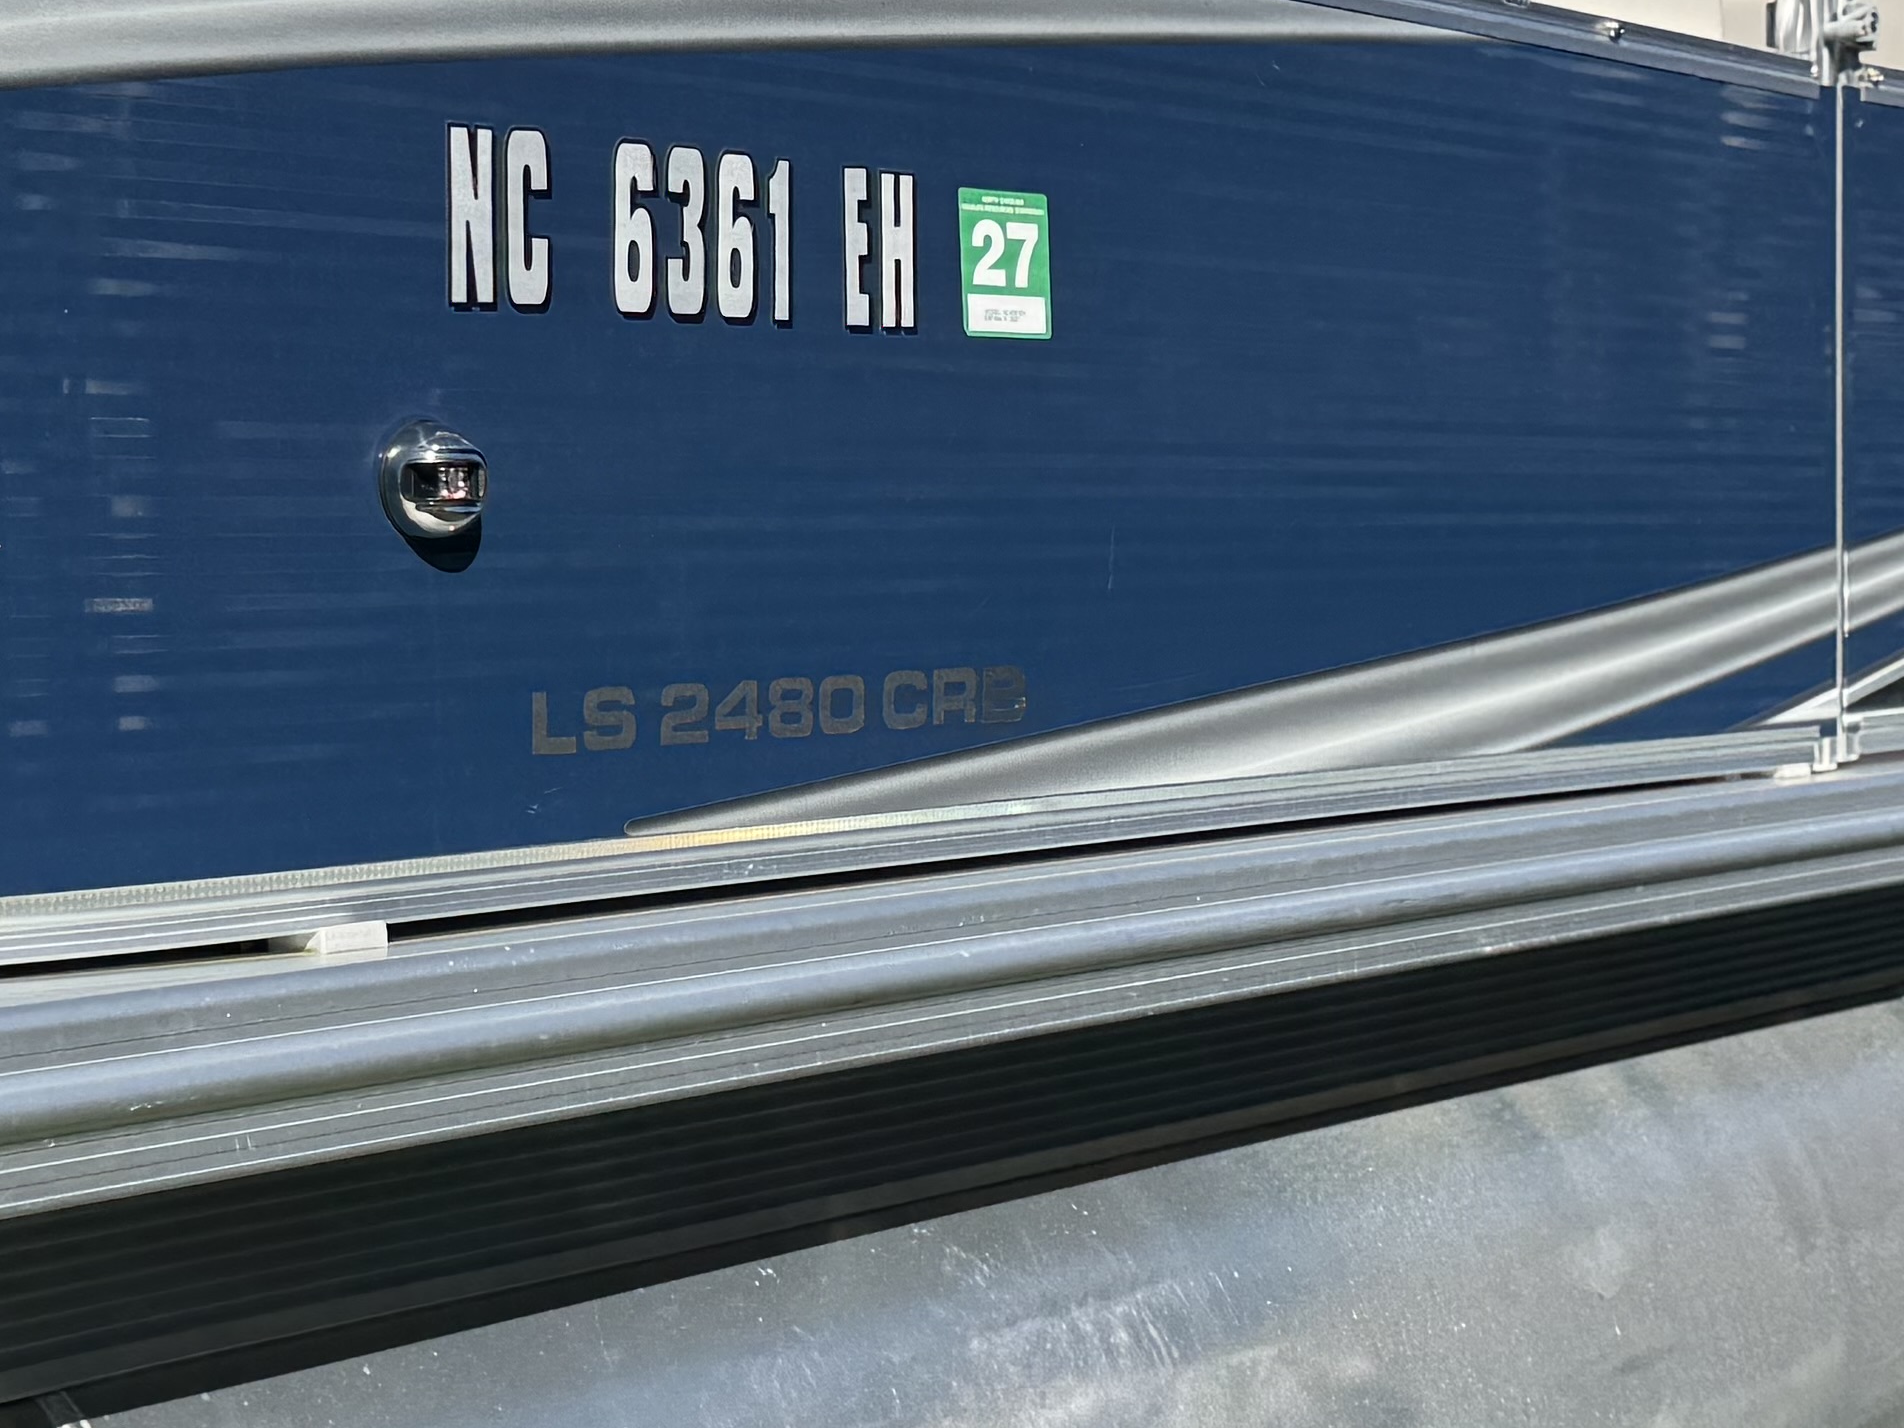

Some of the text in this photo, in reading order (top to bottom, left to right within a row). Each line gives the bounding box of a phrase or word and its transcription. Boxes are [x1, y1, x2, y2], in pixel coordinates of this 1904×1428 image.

[448, 124, 915, 329] NC 6361 EH
[971, 218, 1039, 289] 27
[530, 686, 637, 756] LS
[659, 674, 866, 747] 2480
